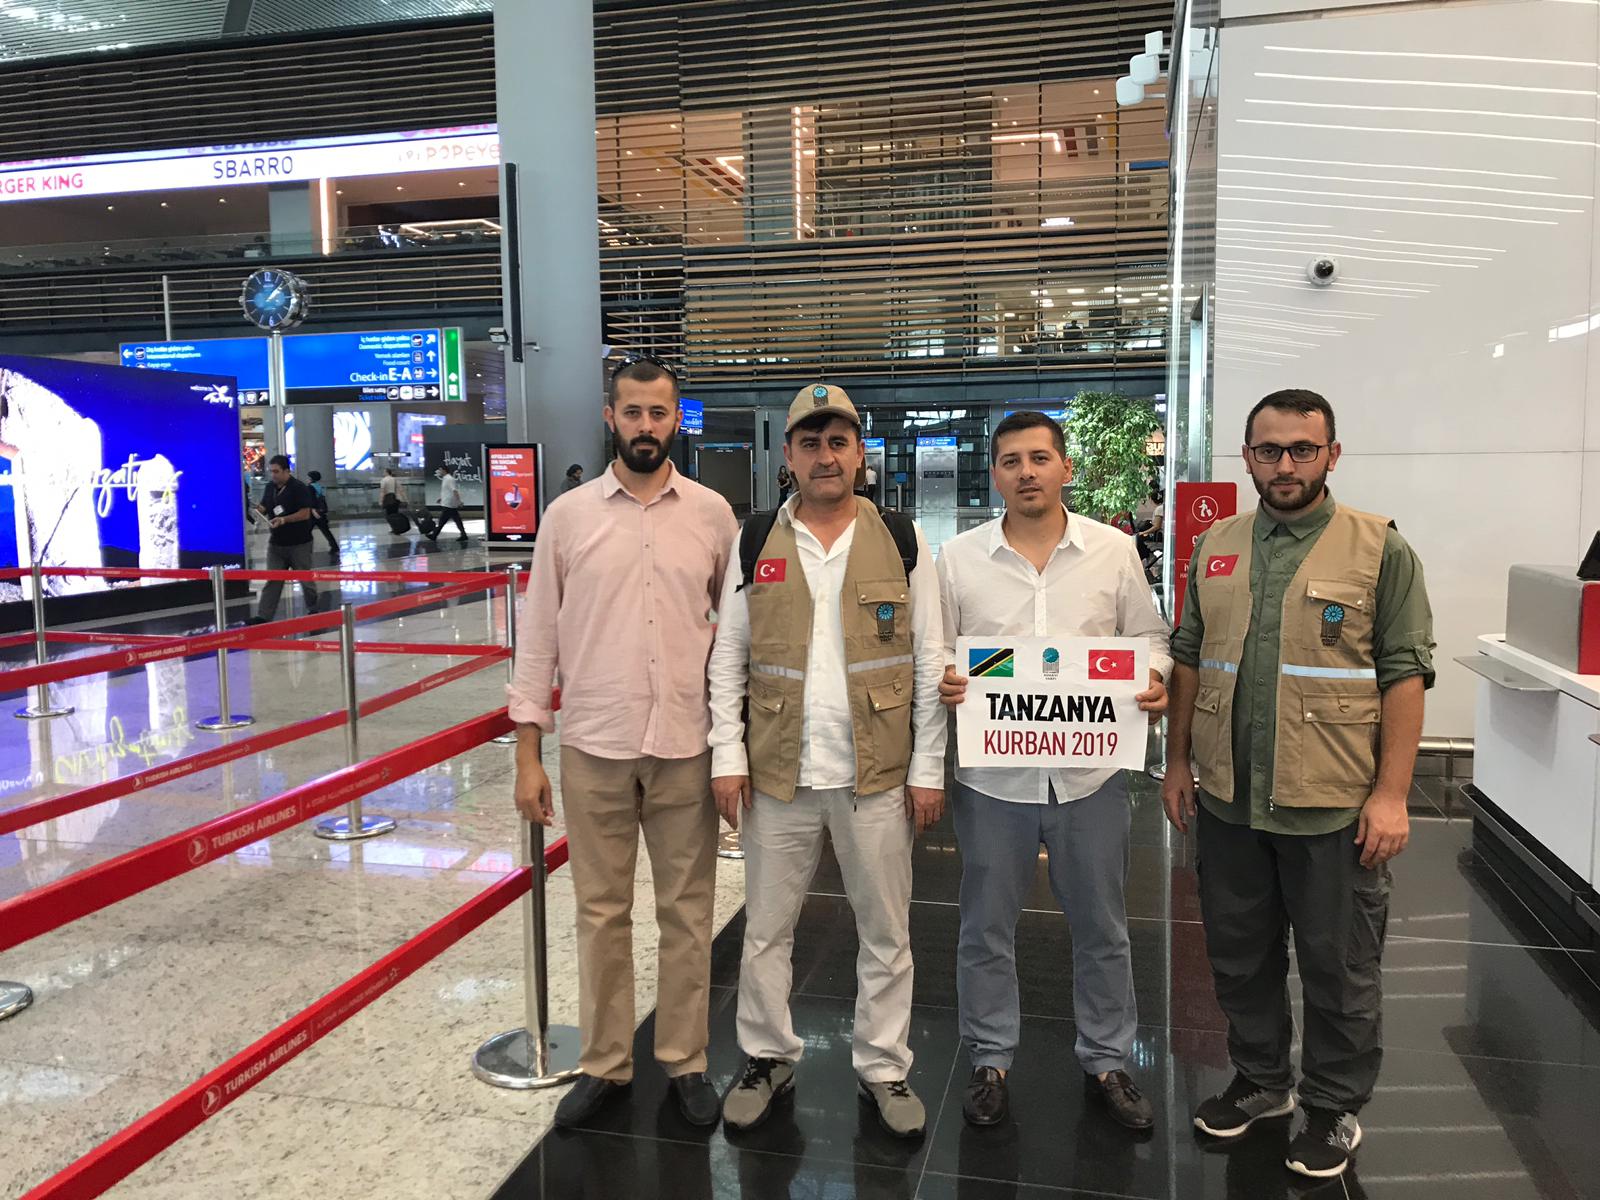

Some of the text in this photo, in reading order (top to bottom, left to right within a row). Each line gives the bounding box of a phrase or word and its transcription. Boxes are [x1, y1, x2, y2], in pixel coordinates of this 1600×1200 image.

[42, 173, 84, 190] KING
[212, 156, 294, 179] SBARRO
[350, 367, 412, 382] Check-in E-A
[985, 692, 1117, 723] TANZANYA
[984, 729, 1119, 757] KURBAN 2019
[211, 822, 256, 849] TURKISH
[256, 805, 297, 832] AIRLINES
[223, 1059, 267, 1095] TURKISH
[268, 1028, 309, 1066] AIRLINES
